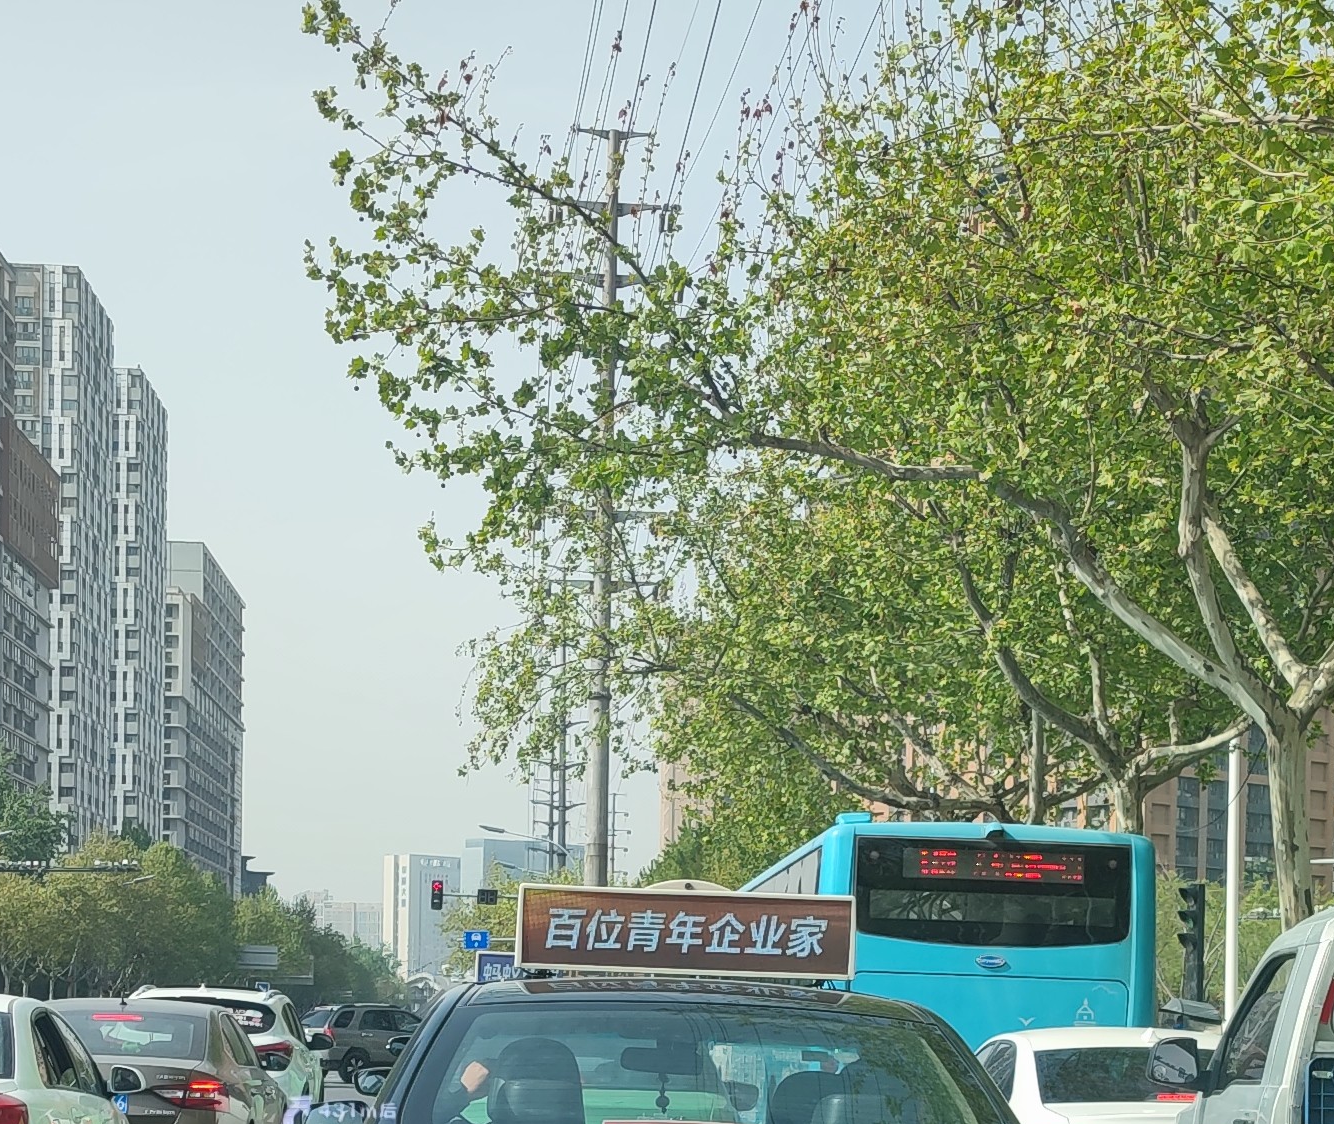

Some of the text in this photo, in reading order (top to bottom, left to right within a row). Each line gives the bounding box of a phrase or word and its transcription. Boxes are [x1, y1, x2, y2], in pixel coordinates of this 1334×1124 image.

[545, 908, 829, 958] 百位青年企业家
